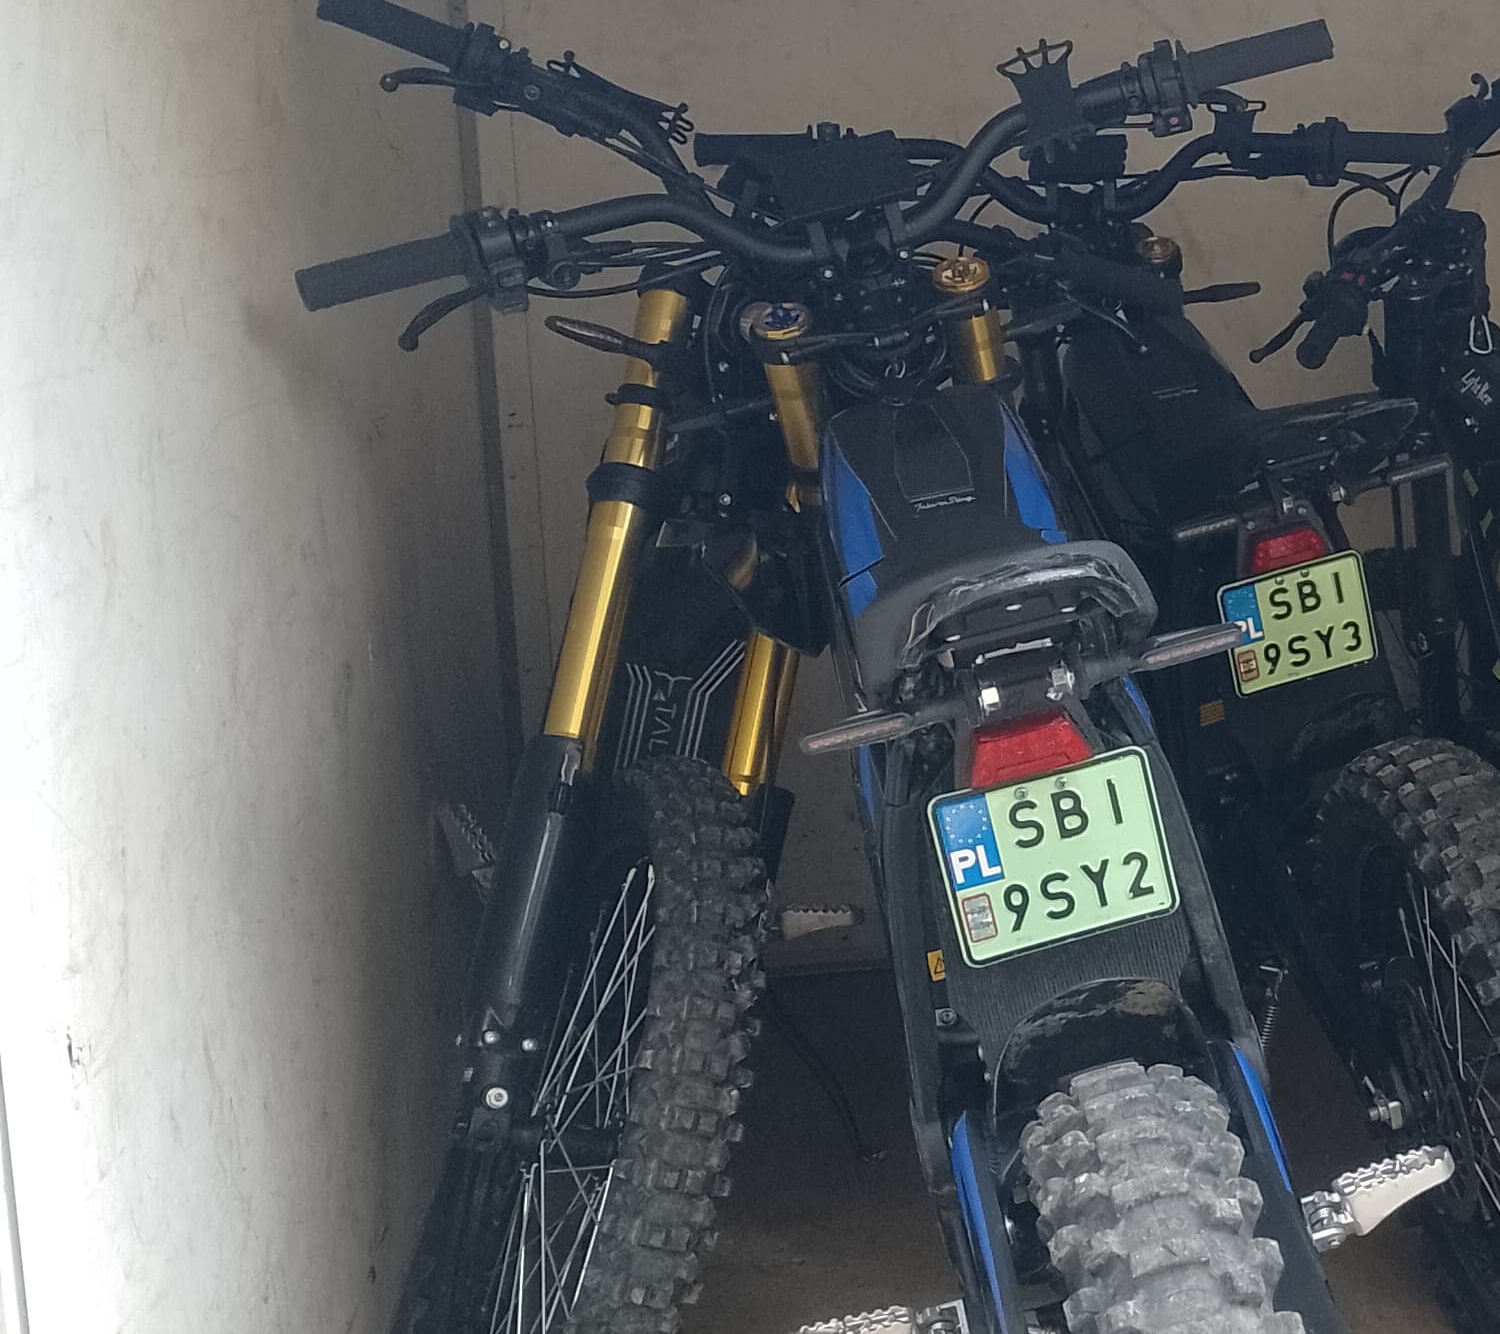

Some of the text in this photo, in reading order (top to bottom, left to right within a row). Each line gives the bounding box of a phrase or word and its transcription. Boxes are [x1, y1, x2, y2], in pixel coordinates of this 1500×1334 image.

[1263, 620, 1362, 676] 9SY3
[950, 844, 1001, 884] PL
[1003, 851, 1155, 932] 9SY2
